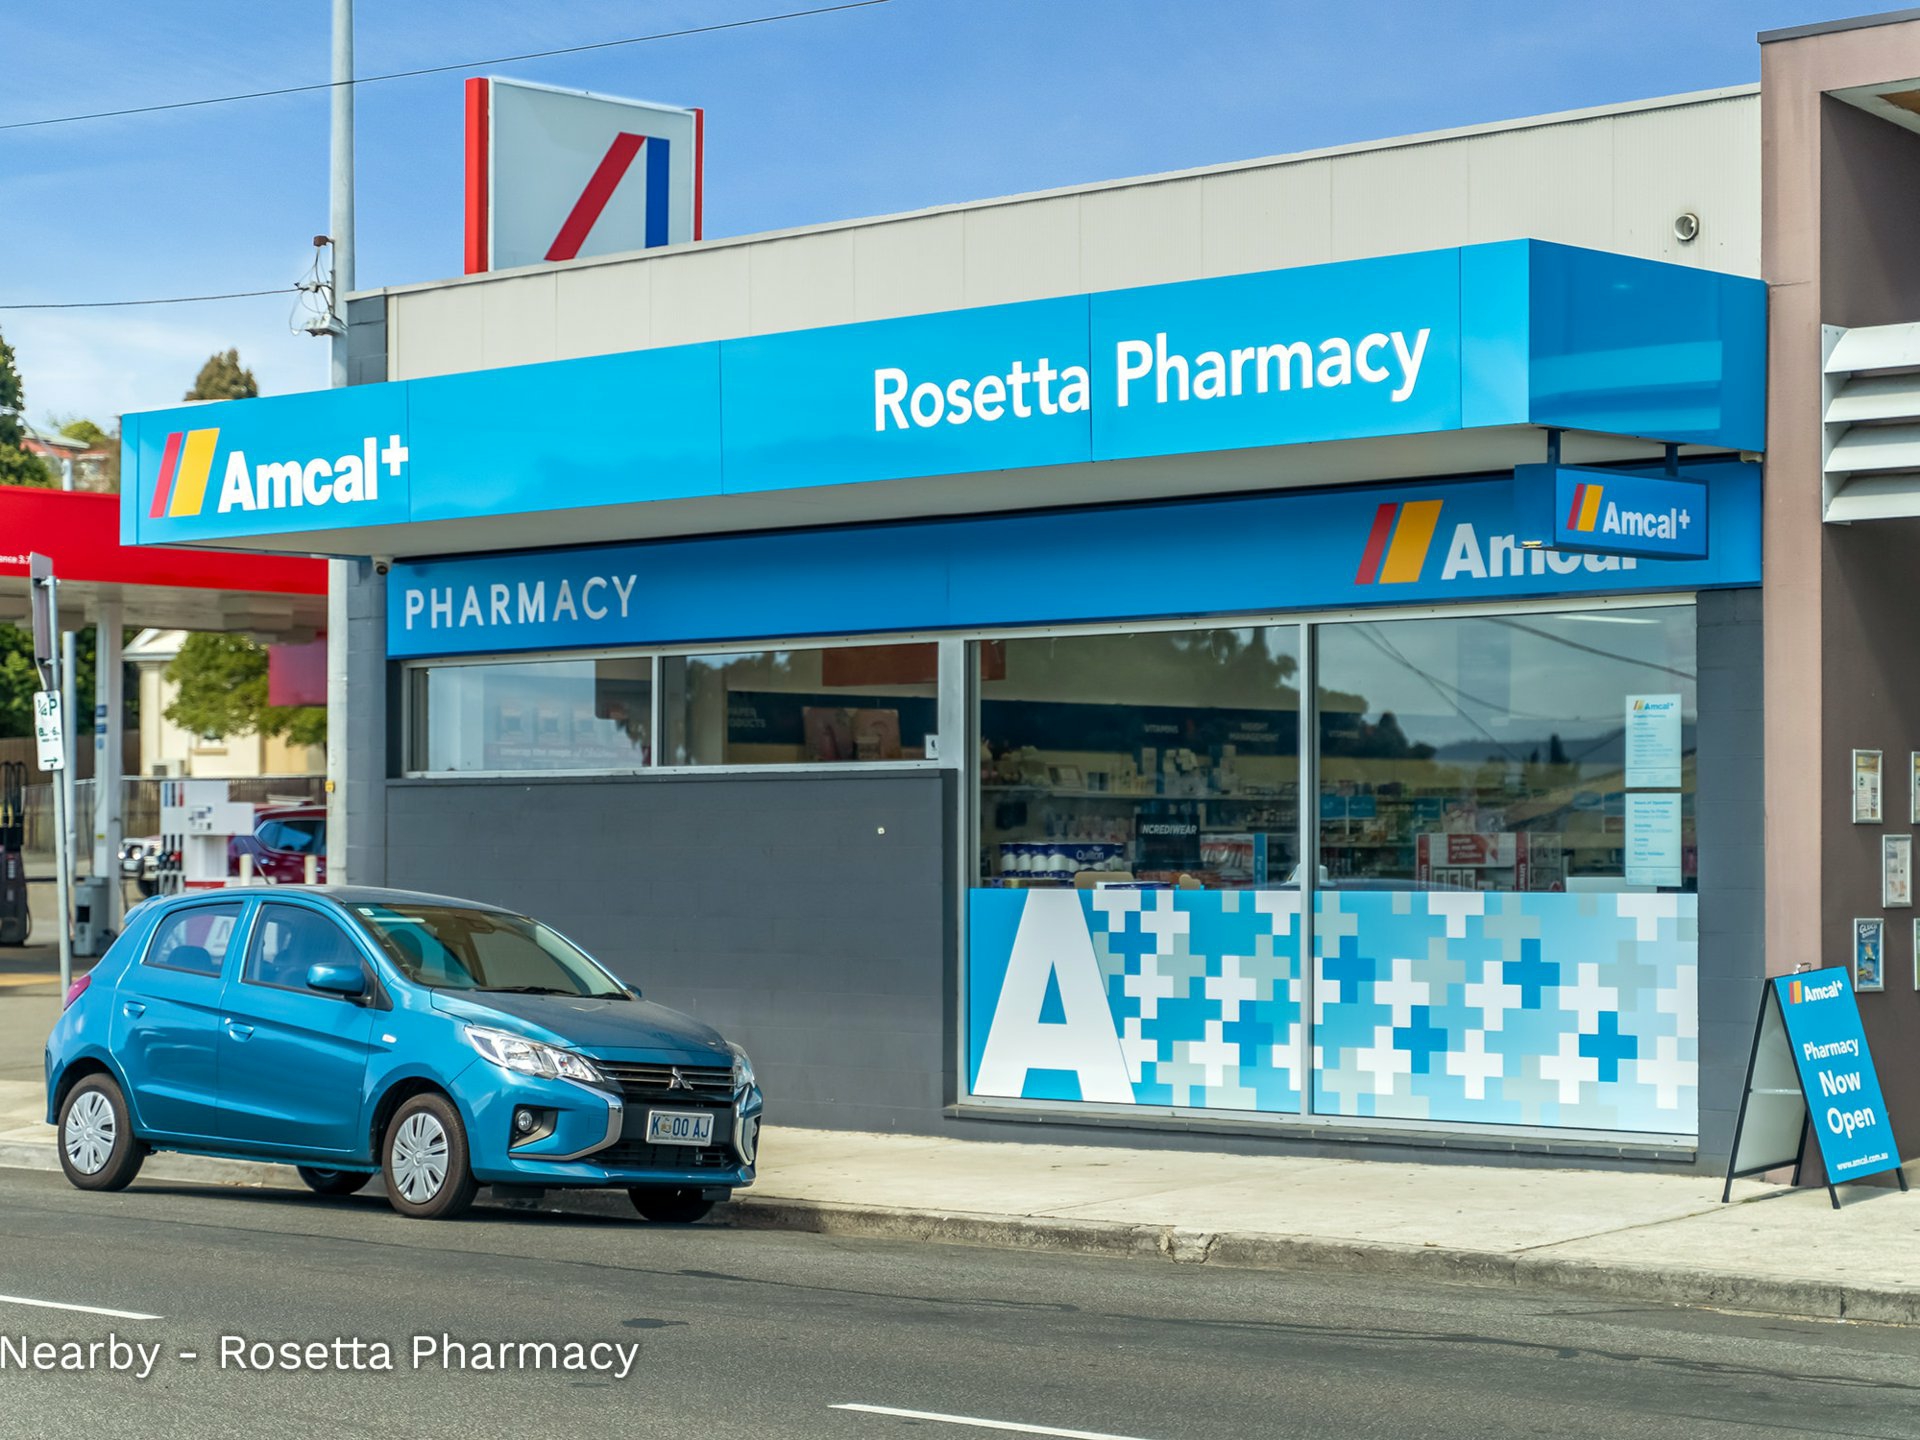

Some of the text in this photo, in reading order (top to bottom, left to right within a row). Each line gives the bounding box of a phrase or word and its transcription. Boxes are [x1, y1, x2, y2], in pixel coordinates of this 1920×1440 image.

[874, 328, 1431, 431] Rosetta Pharmacy
[217, 434, 409, 514] Amcal+
[1602, 501, 1691, 540] Amcal+
[406, 575, 638, 631] PHARMACY
[1804, 979, 1844, 1002] Amcal+
[1803, 1038, 1859, 1061] Pharmacy
[1818, 1069, 1862, 1097] Now
[1826, 1107, 1876, 1139] Open
[1836, 1152, 1889, 1171] www.amcal.com.au
